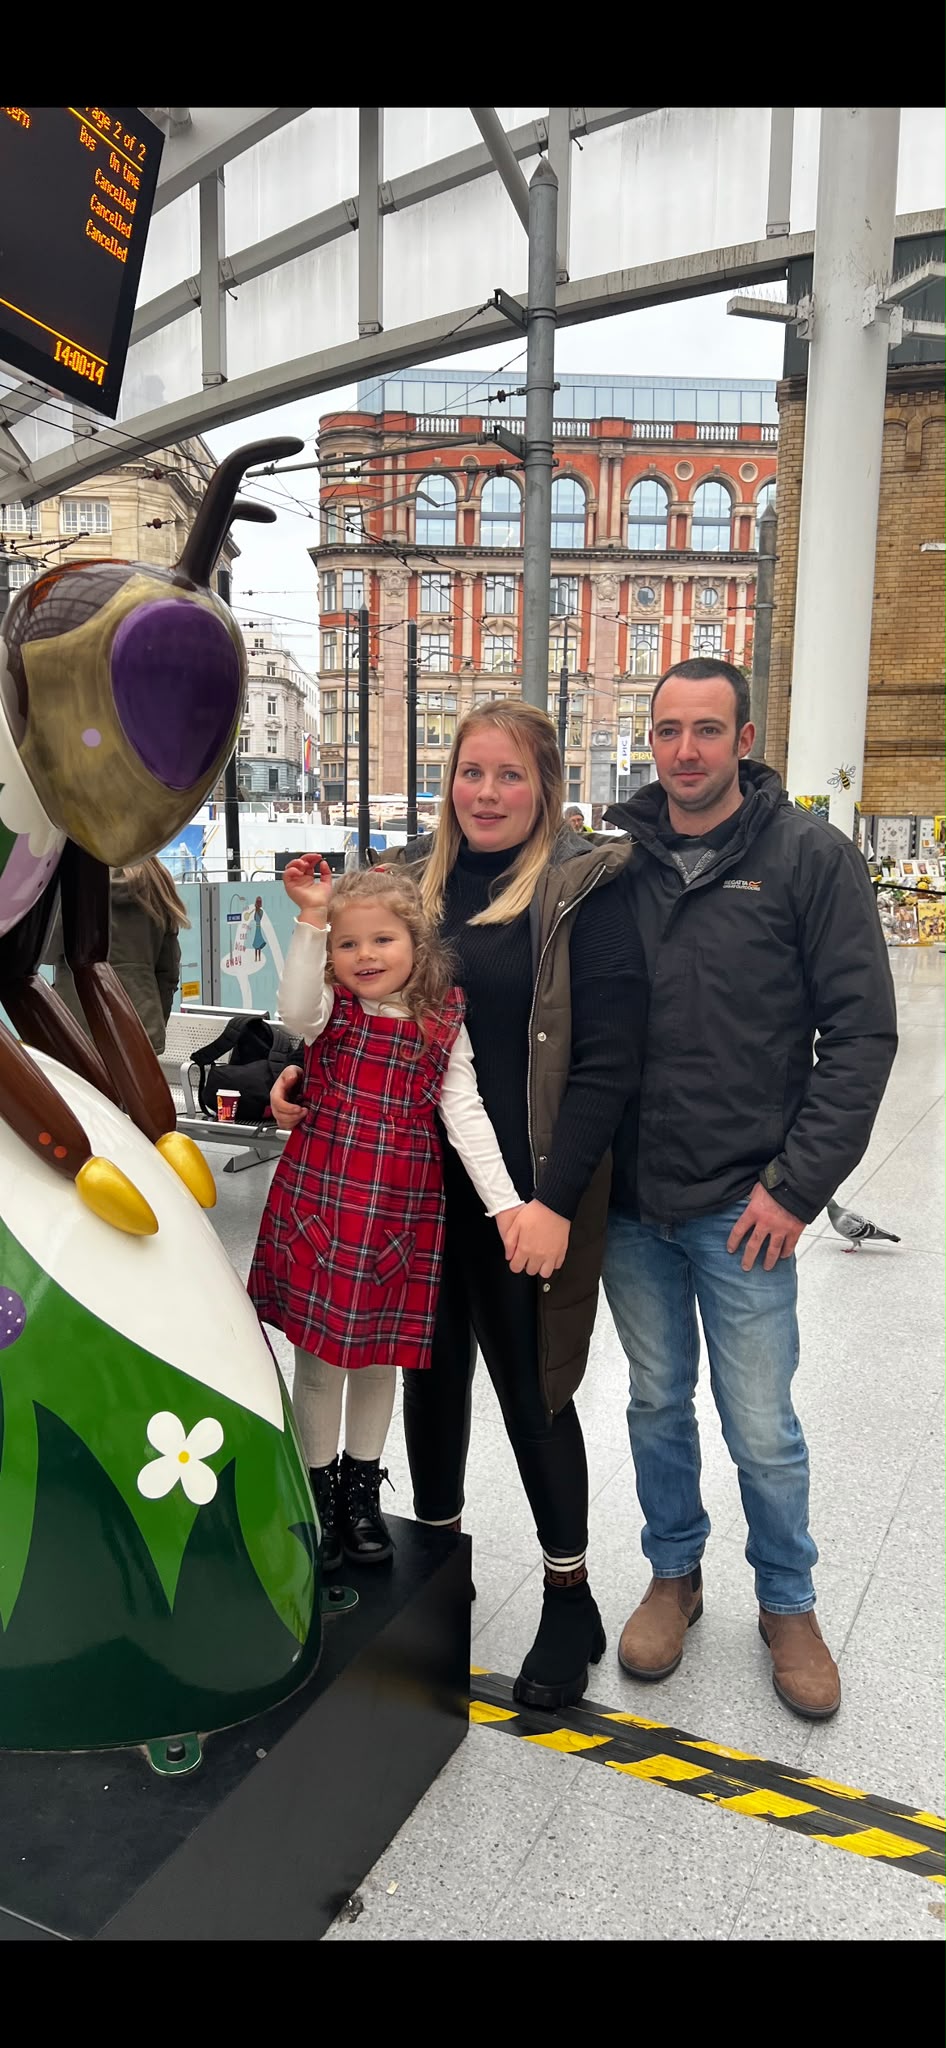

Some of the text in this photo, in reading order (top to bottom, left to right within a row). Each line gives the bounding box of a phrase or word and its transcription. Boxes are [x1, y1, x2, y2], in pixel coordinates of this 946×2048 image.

[80, 124, 97, 151] Bus
[85, 107, 147, 161] age 2 of 2
[94, 168, 137, 214] Cancelled
[109, 151, 140, 190] On time
[90, 194, 131, 239] Cancelled
[85, 219, 128, 263] Cancelled
[54, 341, 105, 386] 14:00:14
